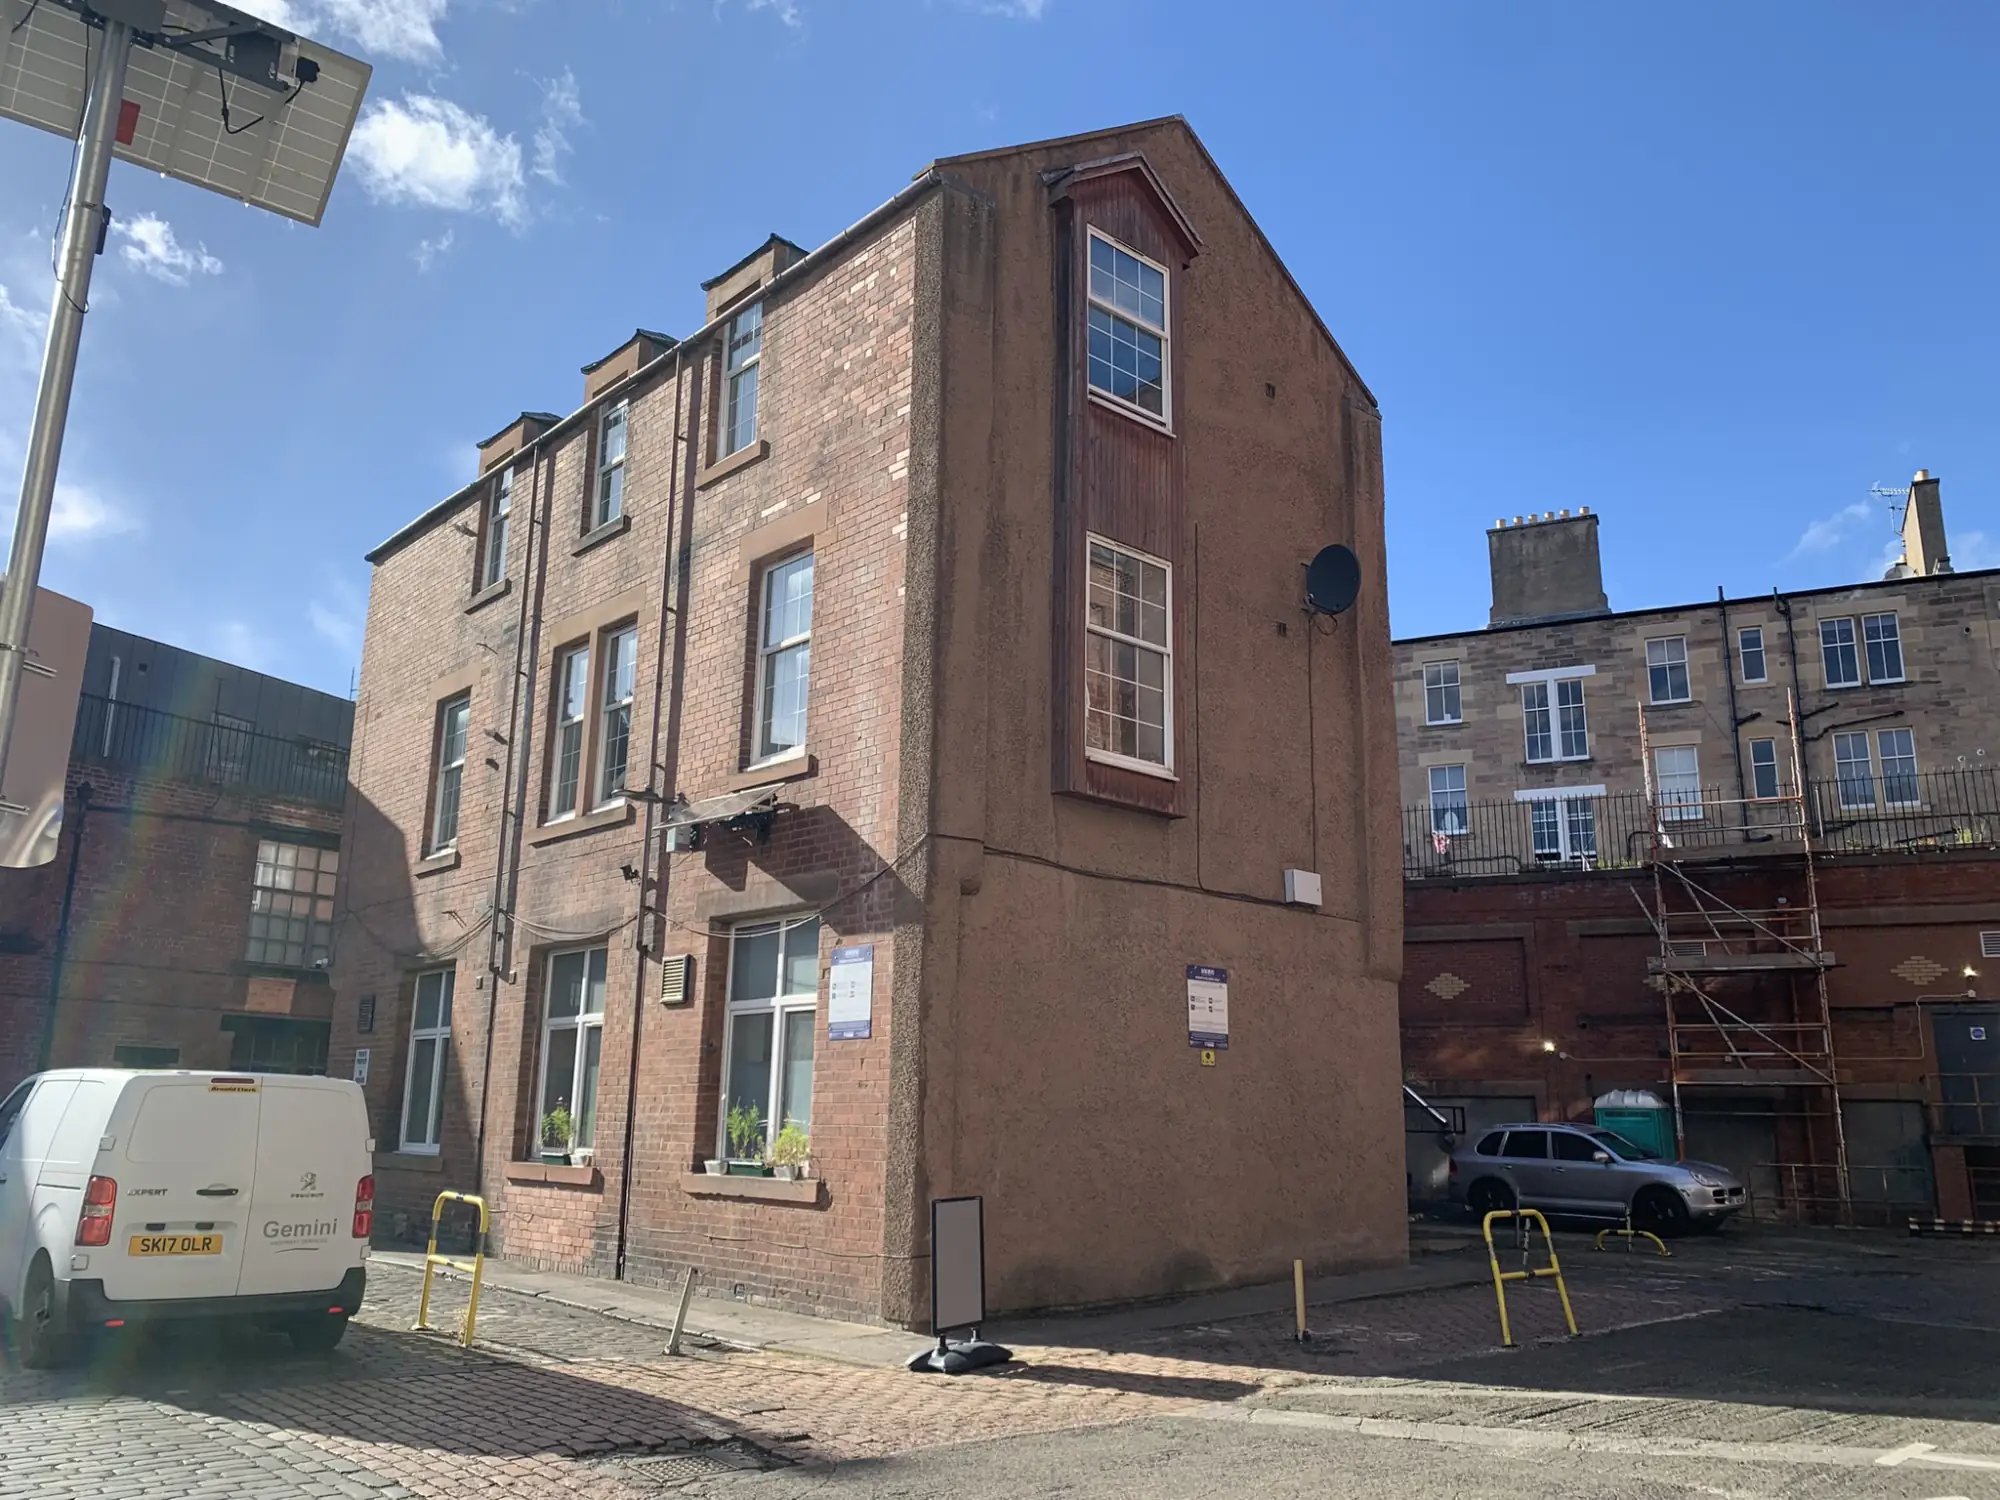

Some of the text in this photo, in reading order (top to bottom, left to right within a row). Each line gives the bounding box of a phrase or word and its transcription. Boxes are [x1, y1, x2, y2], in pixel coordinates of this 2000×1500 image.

[263, 1218, 338, 1238] Gemini
[140, 1237, 212, 1252] SK17 OLR
